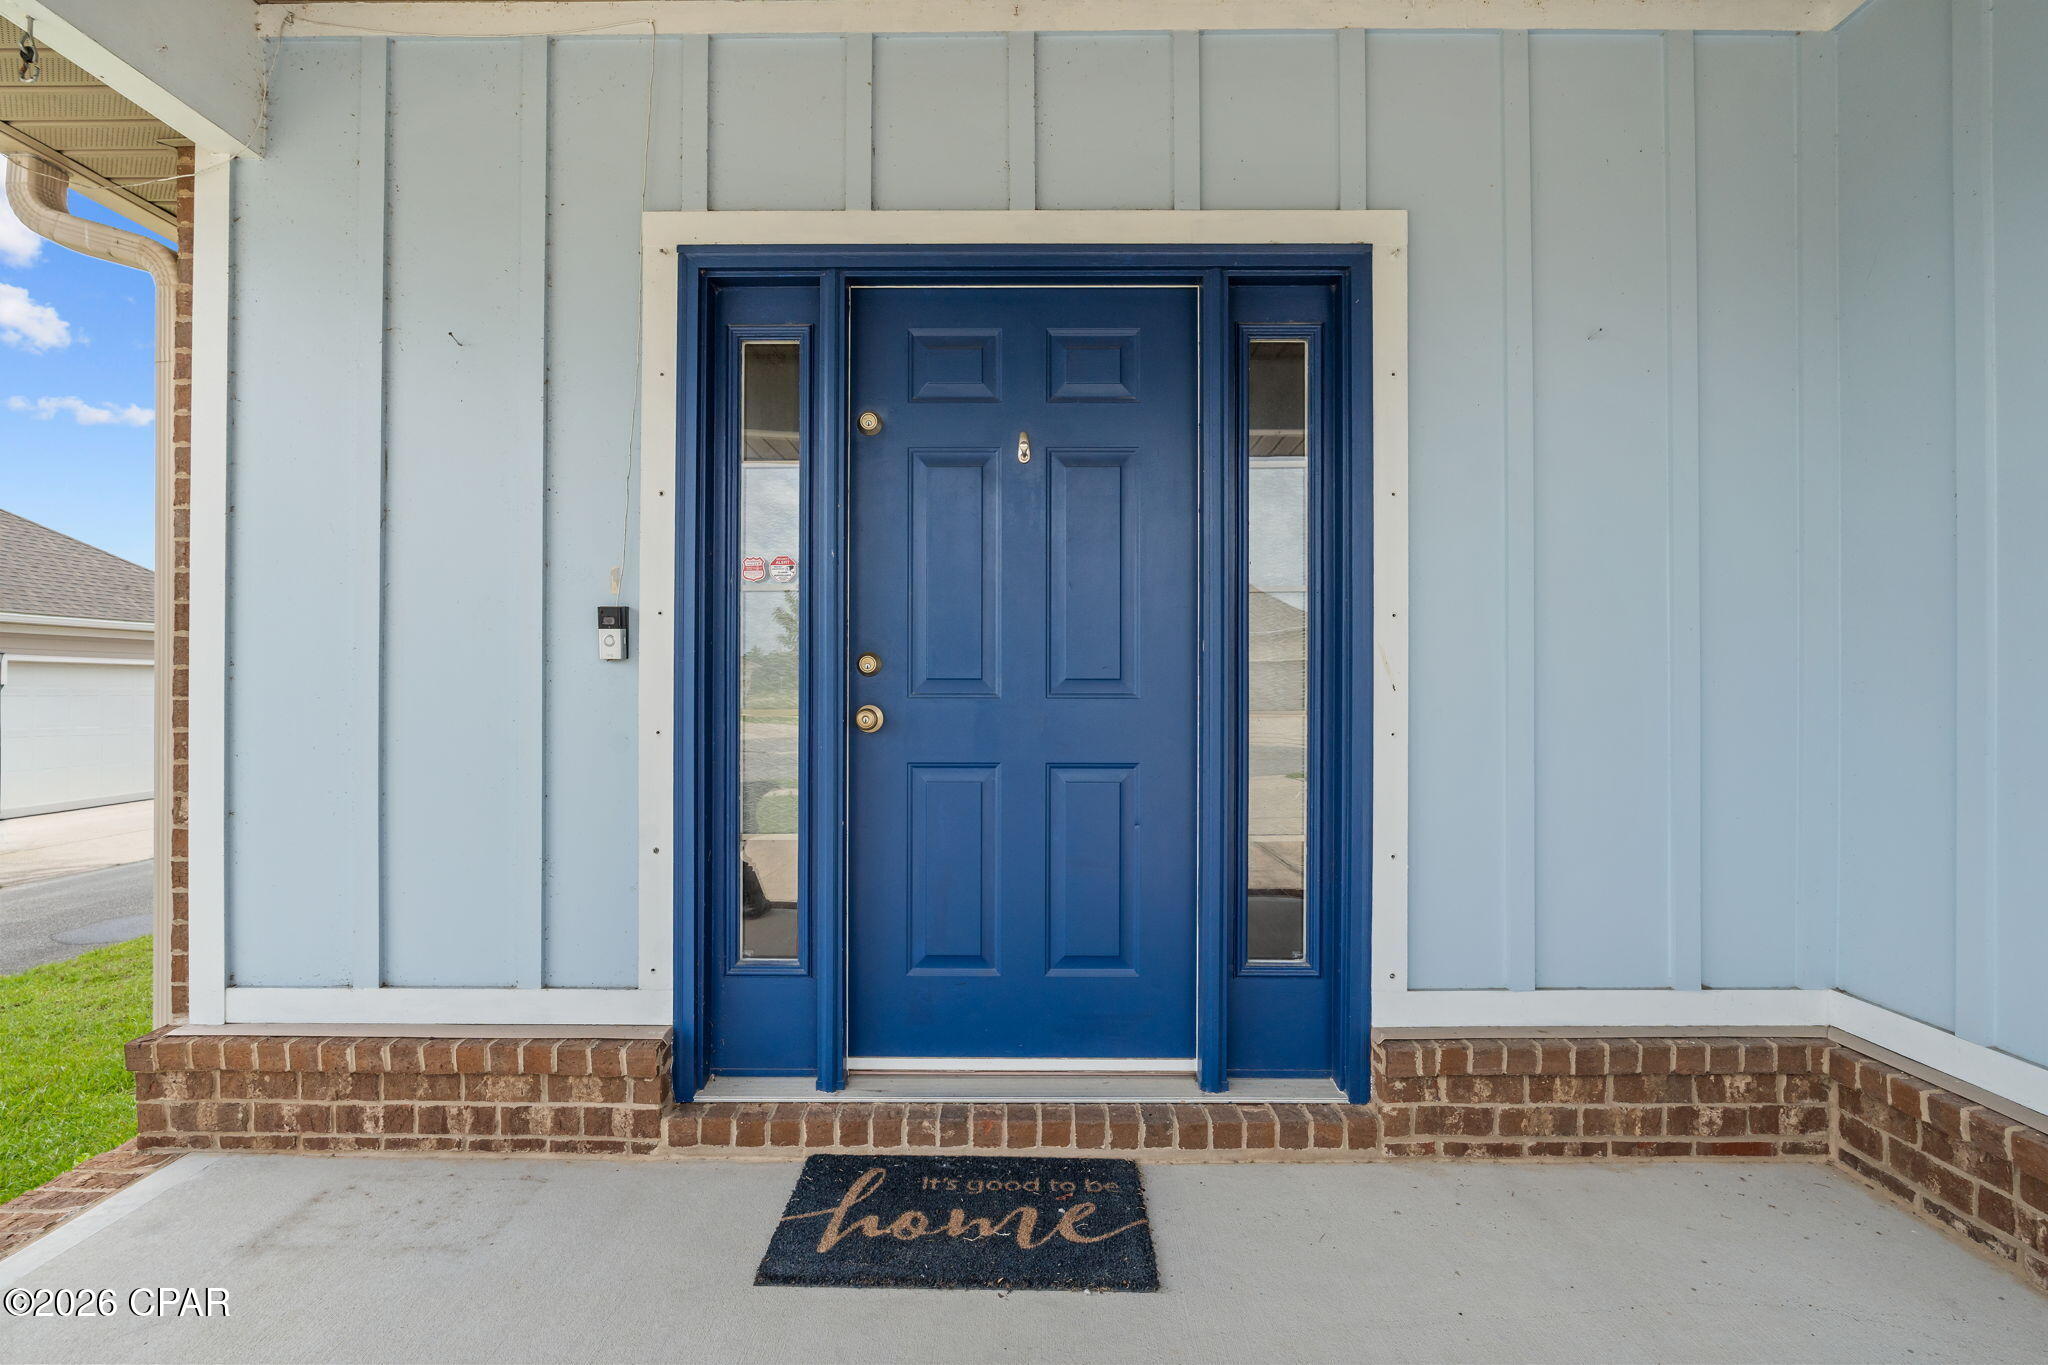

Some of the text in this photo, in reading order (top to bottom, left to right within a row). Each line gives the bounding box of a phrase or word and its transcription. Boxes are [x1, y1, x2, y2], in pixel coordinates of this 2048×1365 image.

[780, 1167, 1148, 1253] home
[967, 1176, 1042, 1194] good
[1050, 1177, 1075, 1192] to
[1084, 1177, 1120, 1193] be
